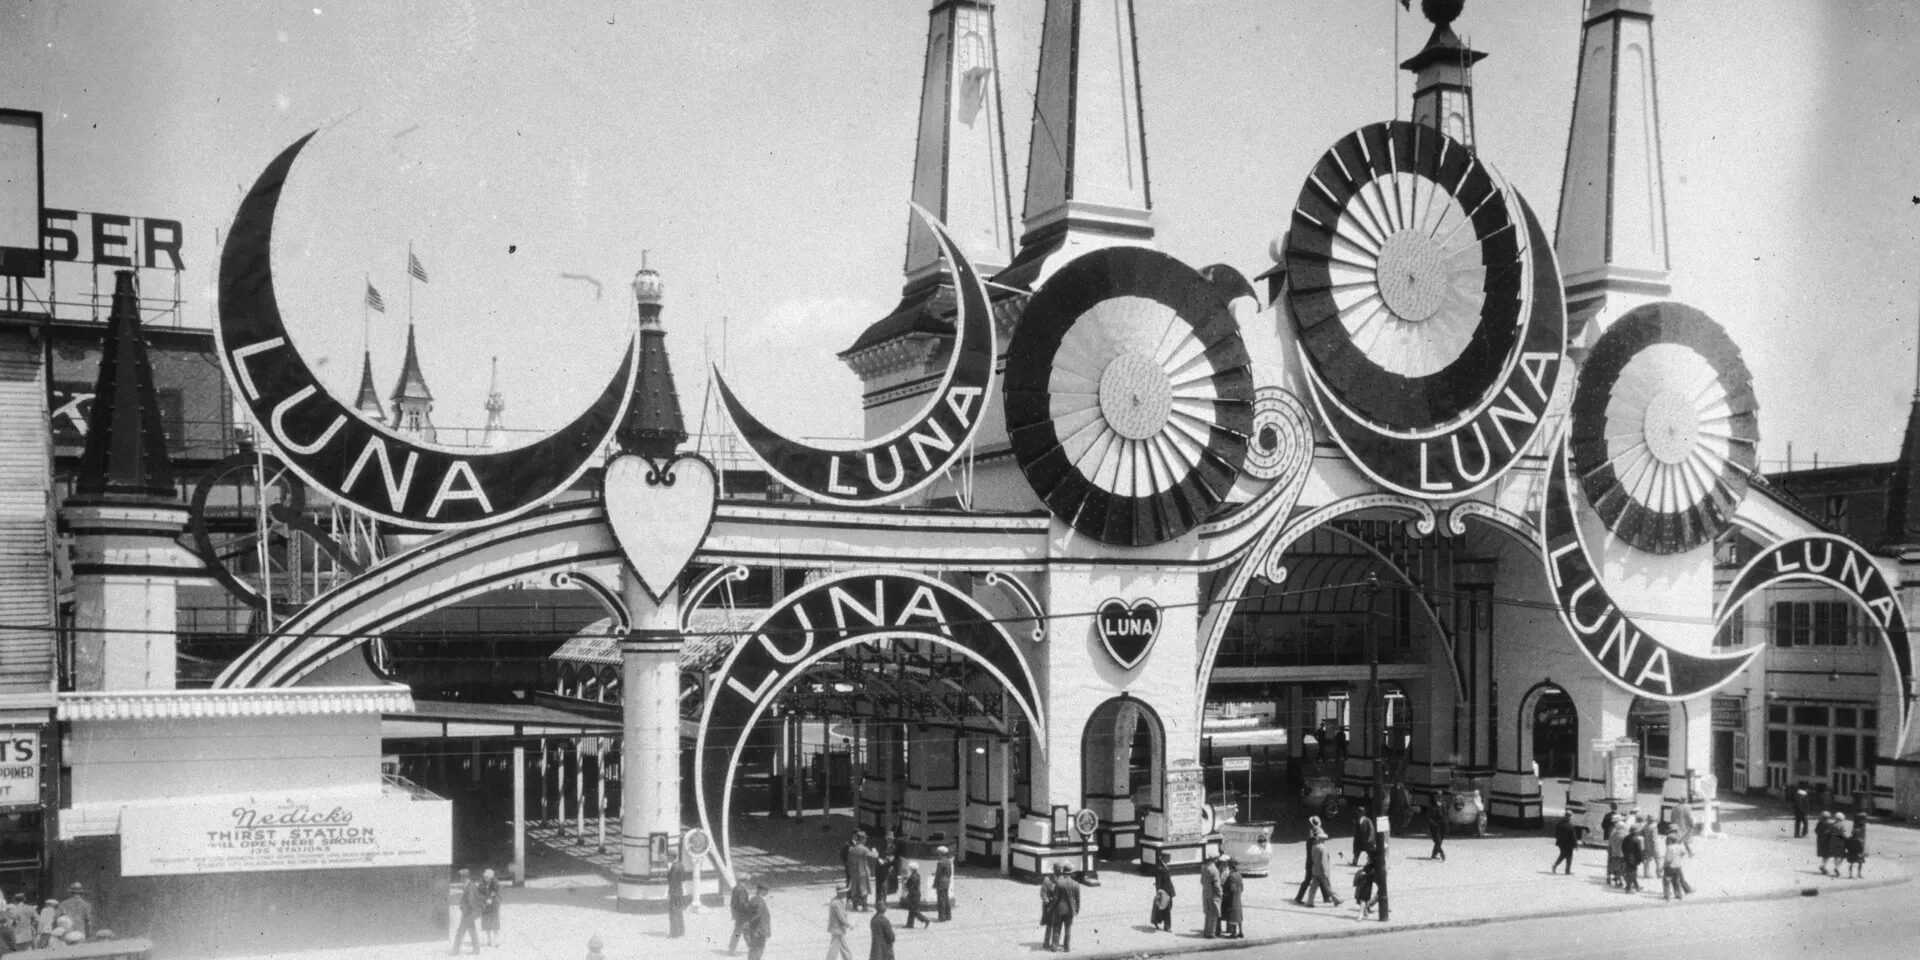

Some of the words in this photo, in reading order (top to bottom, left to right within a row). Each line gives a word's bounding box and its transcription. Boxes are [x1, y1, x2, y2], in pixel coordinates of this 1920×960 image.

[233, 336, 493, 519] LUNA
[828, 385, 983, 495] LUNA
[1420, 351, 1559, 491] LUNA
[1105, 618, 1154, 638] LUNA
[1550, 541, 1673, 695] LUNA
[1776, 542, 1894, 628] LUNA
[727, 579, 952, 704] LUNA
[207, 829, 276, 842] THIRST
[290, 827, 374, 839] STATION
[232, 806, 353, 828] Nedick's
[240, 840, 276, 848] OPEN
[281, 838, 314, 846] HERE
[277, 845, 331, 853] STATIONS
